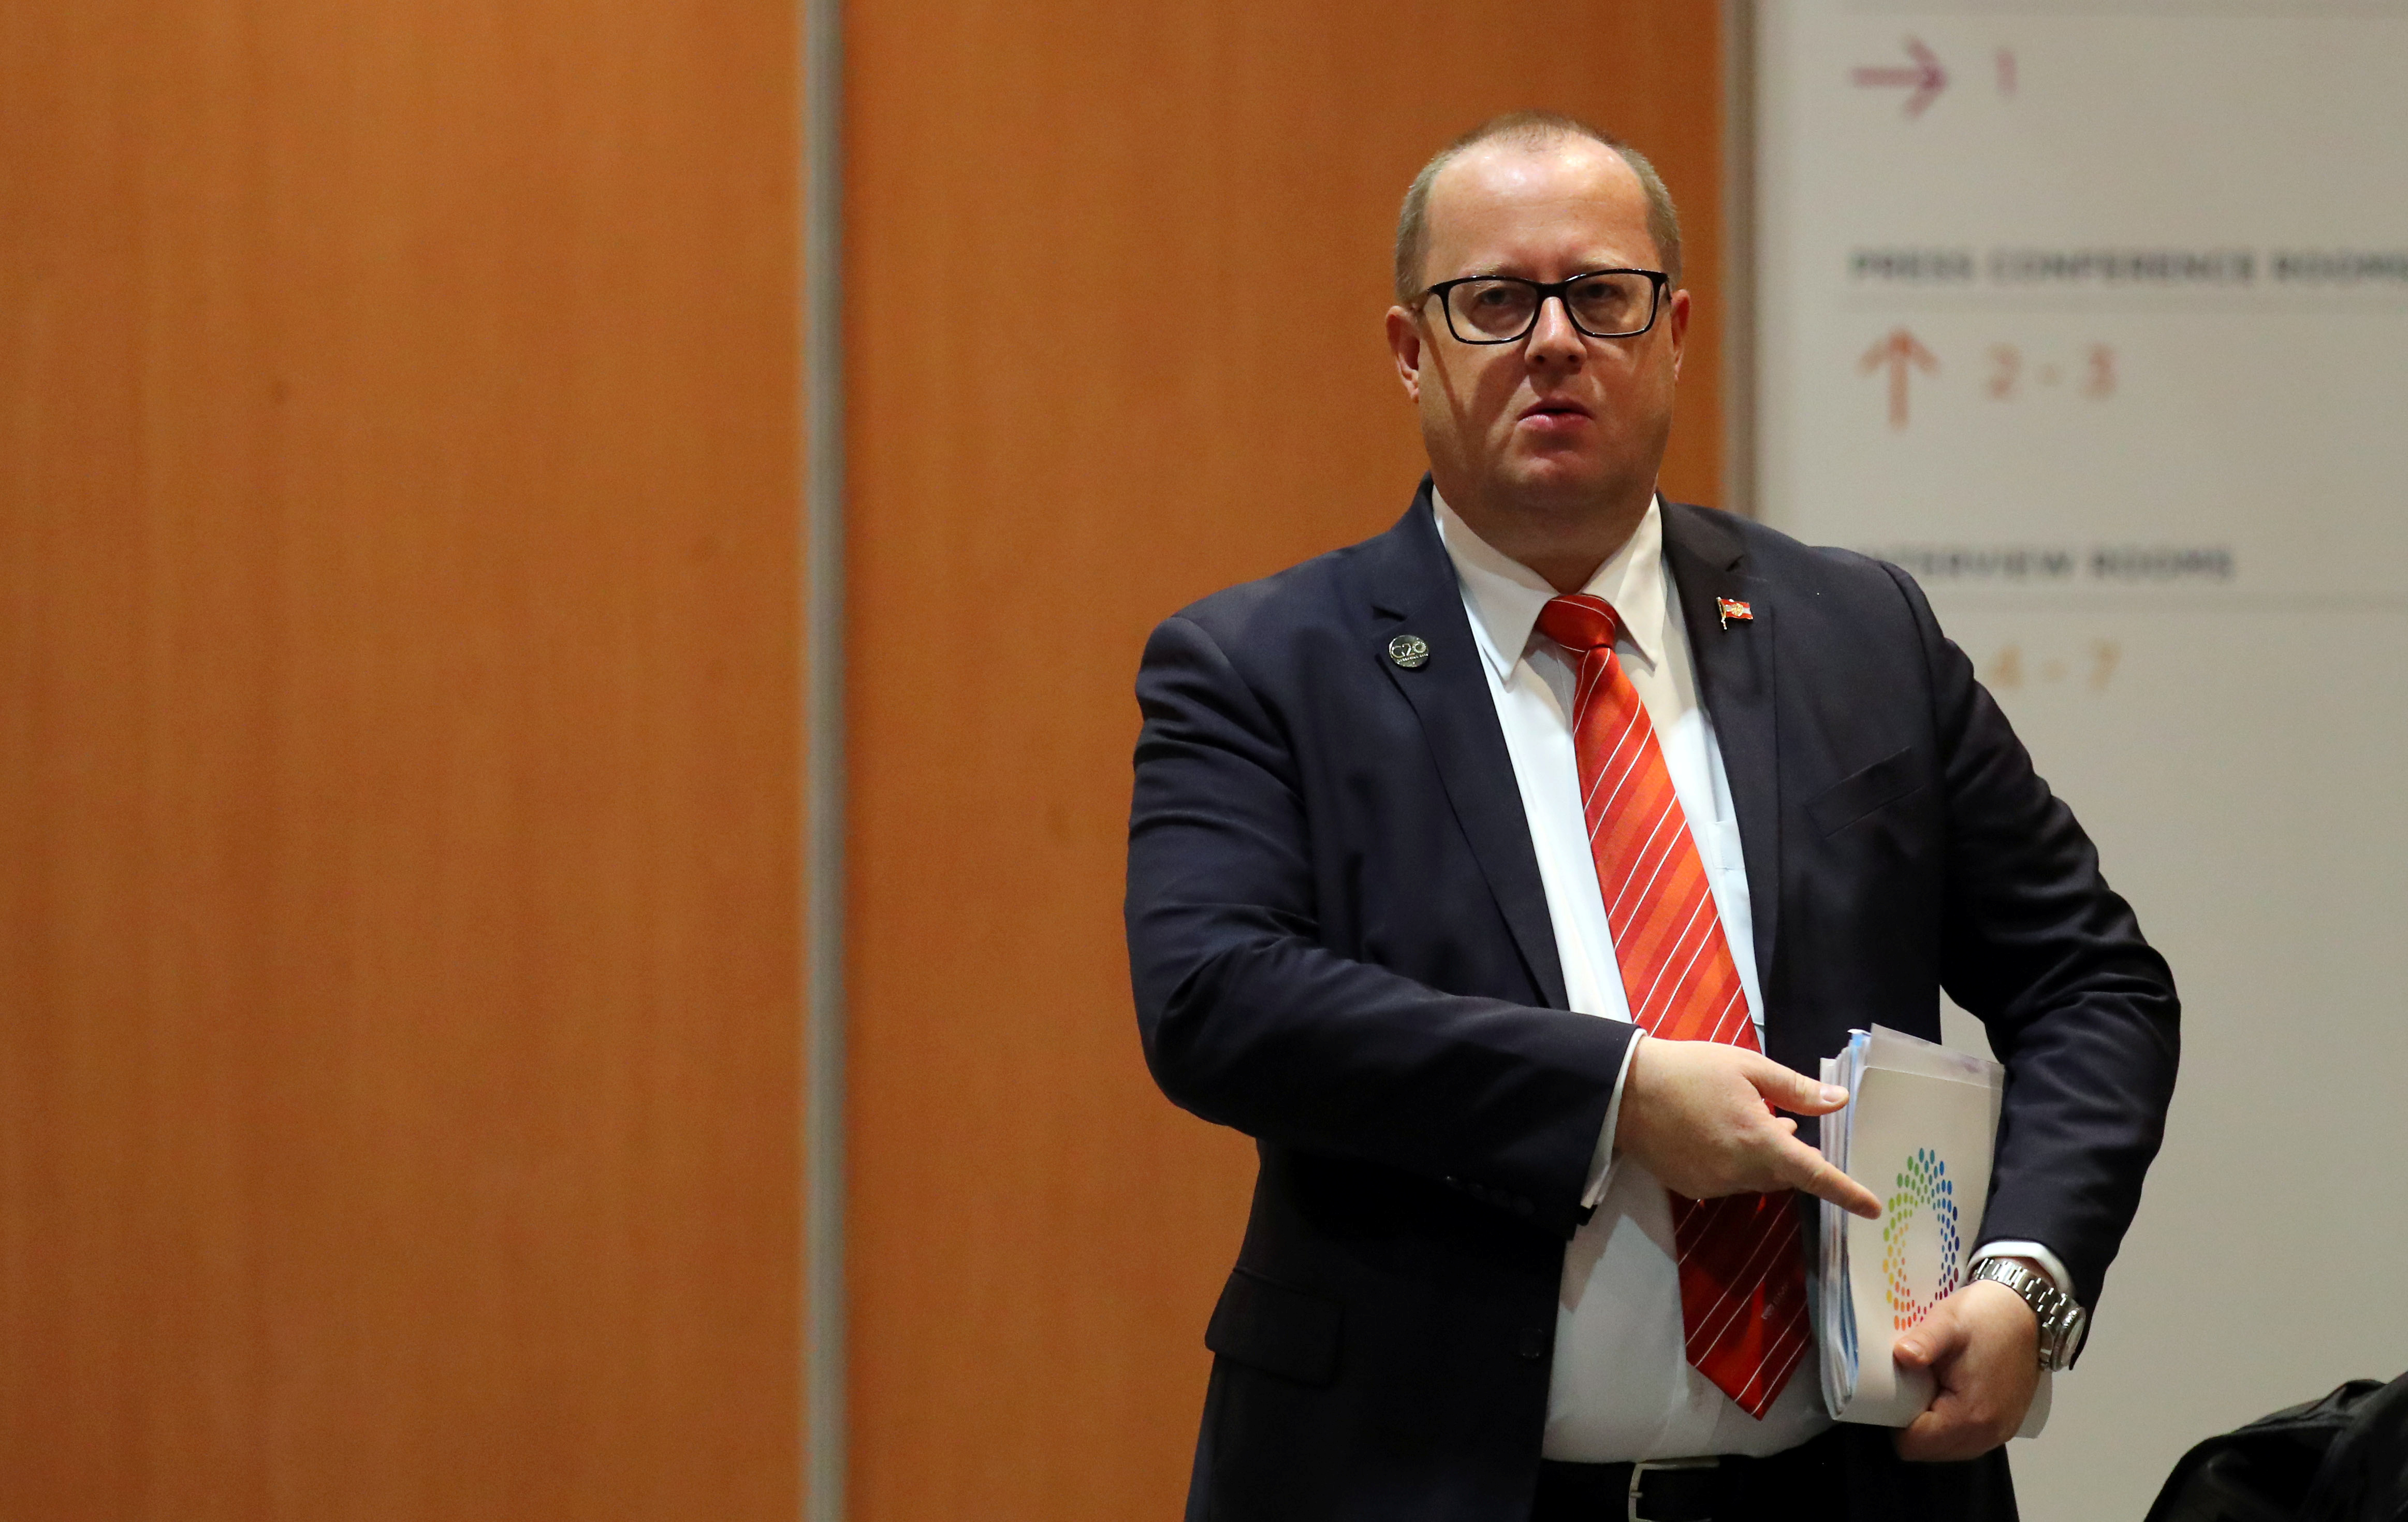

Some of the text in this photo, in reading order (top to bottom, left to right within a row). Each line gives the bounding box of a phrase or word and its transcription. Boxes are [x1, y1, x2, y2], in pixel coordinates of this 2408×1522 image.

[1993, 47, 2017, 96] 1
[1851, 250, 1974, 283] PRESS
[1988, 250, 2254, 283] CONFERENCE
[1986, 344, 2020, 399] 2
[2082, 344, 2117, 399] 3
[2088, 546, 2232, 579] ROOMS
[1988, 644, 2022, 688] 4
[2090, 642, 2120, 689] 7
